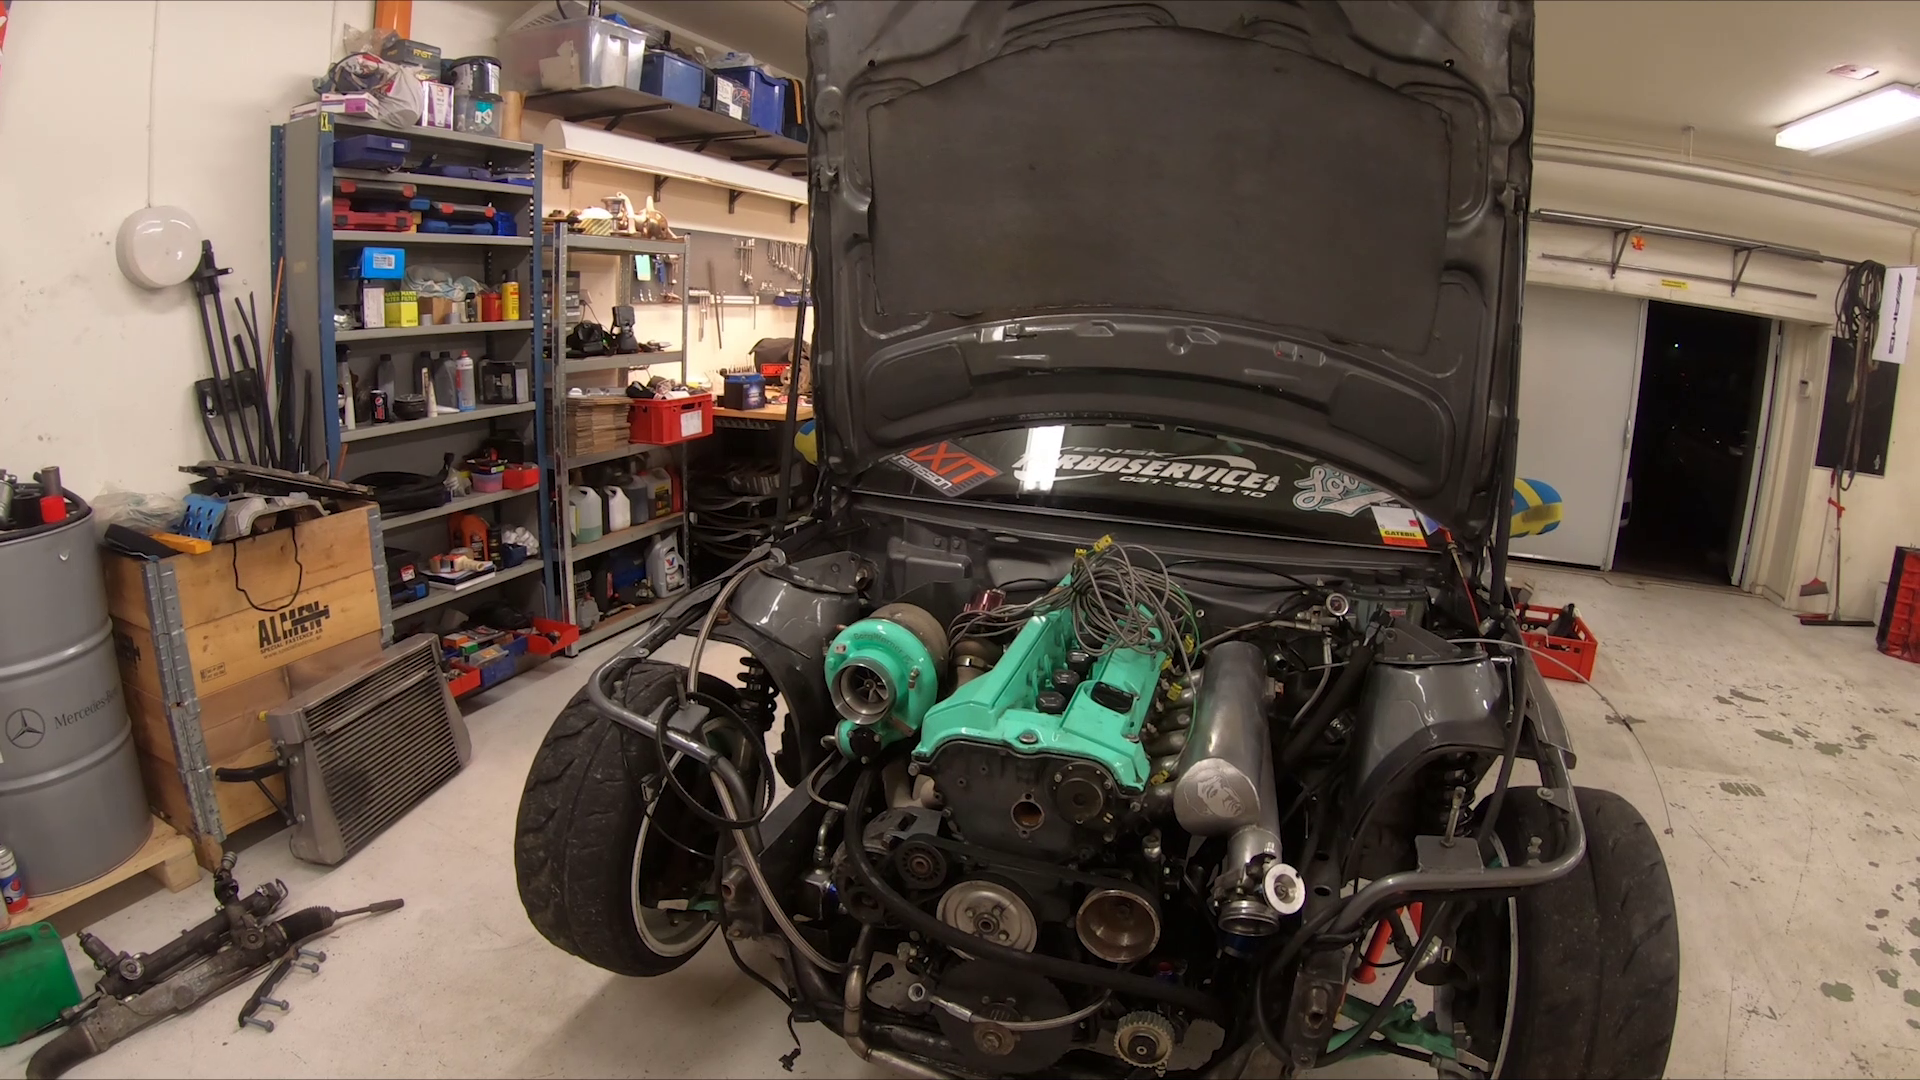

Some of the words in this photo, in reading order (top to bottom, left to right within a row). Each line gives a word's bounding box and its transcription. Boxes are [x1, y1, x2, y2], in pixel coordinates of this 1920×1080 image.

[1011, 453, 1269, 490] TRBOSERVICE
[1119, 476, 1161, 485] 031
[1241, 490, 1267, 498] 10
[260, 643, 283, 655] SPECIAL
